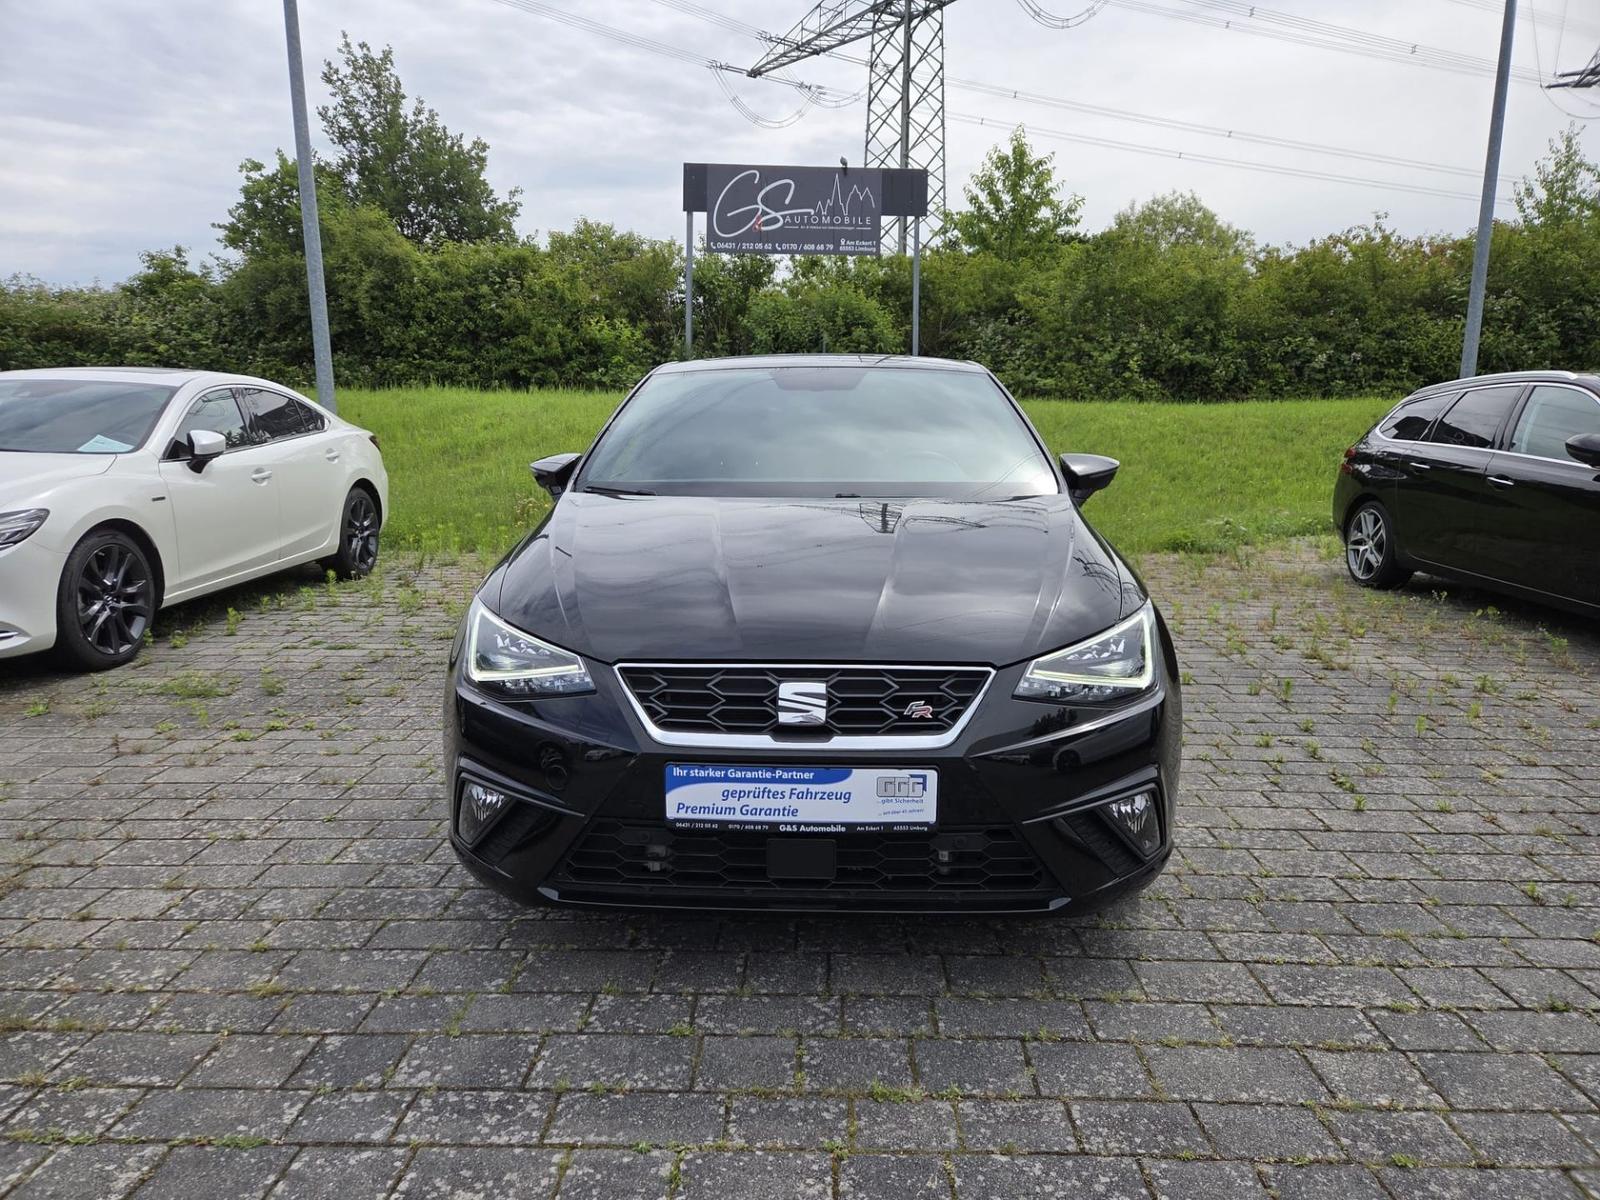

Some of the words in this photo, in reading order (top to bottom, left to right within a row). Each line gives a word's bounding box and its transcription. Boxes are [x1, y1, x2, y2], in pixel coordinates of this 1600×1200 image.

[784, 216, 871, 225] AUTOMOBILE
[742, 242, 754, 250] 212
[673, 768, 687, 777] Ihr
[690, 768, 726, 778] starker
[727, 769, 815, 779] Garantie-Partner
[721, 787, 786, 802] geprüftes
[788, 788, 852, 804] Fahrzeug
[676, 802, 736, 816] Premium
[740, 804, 799, 817] Garantie
[779, 824, 797, 832] G&S
[799, 824, 846, 832] Automobile
